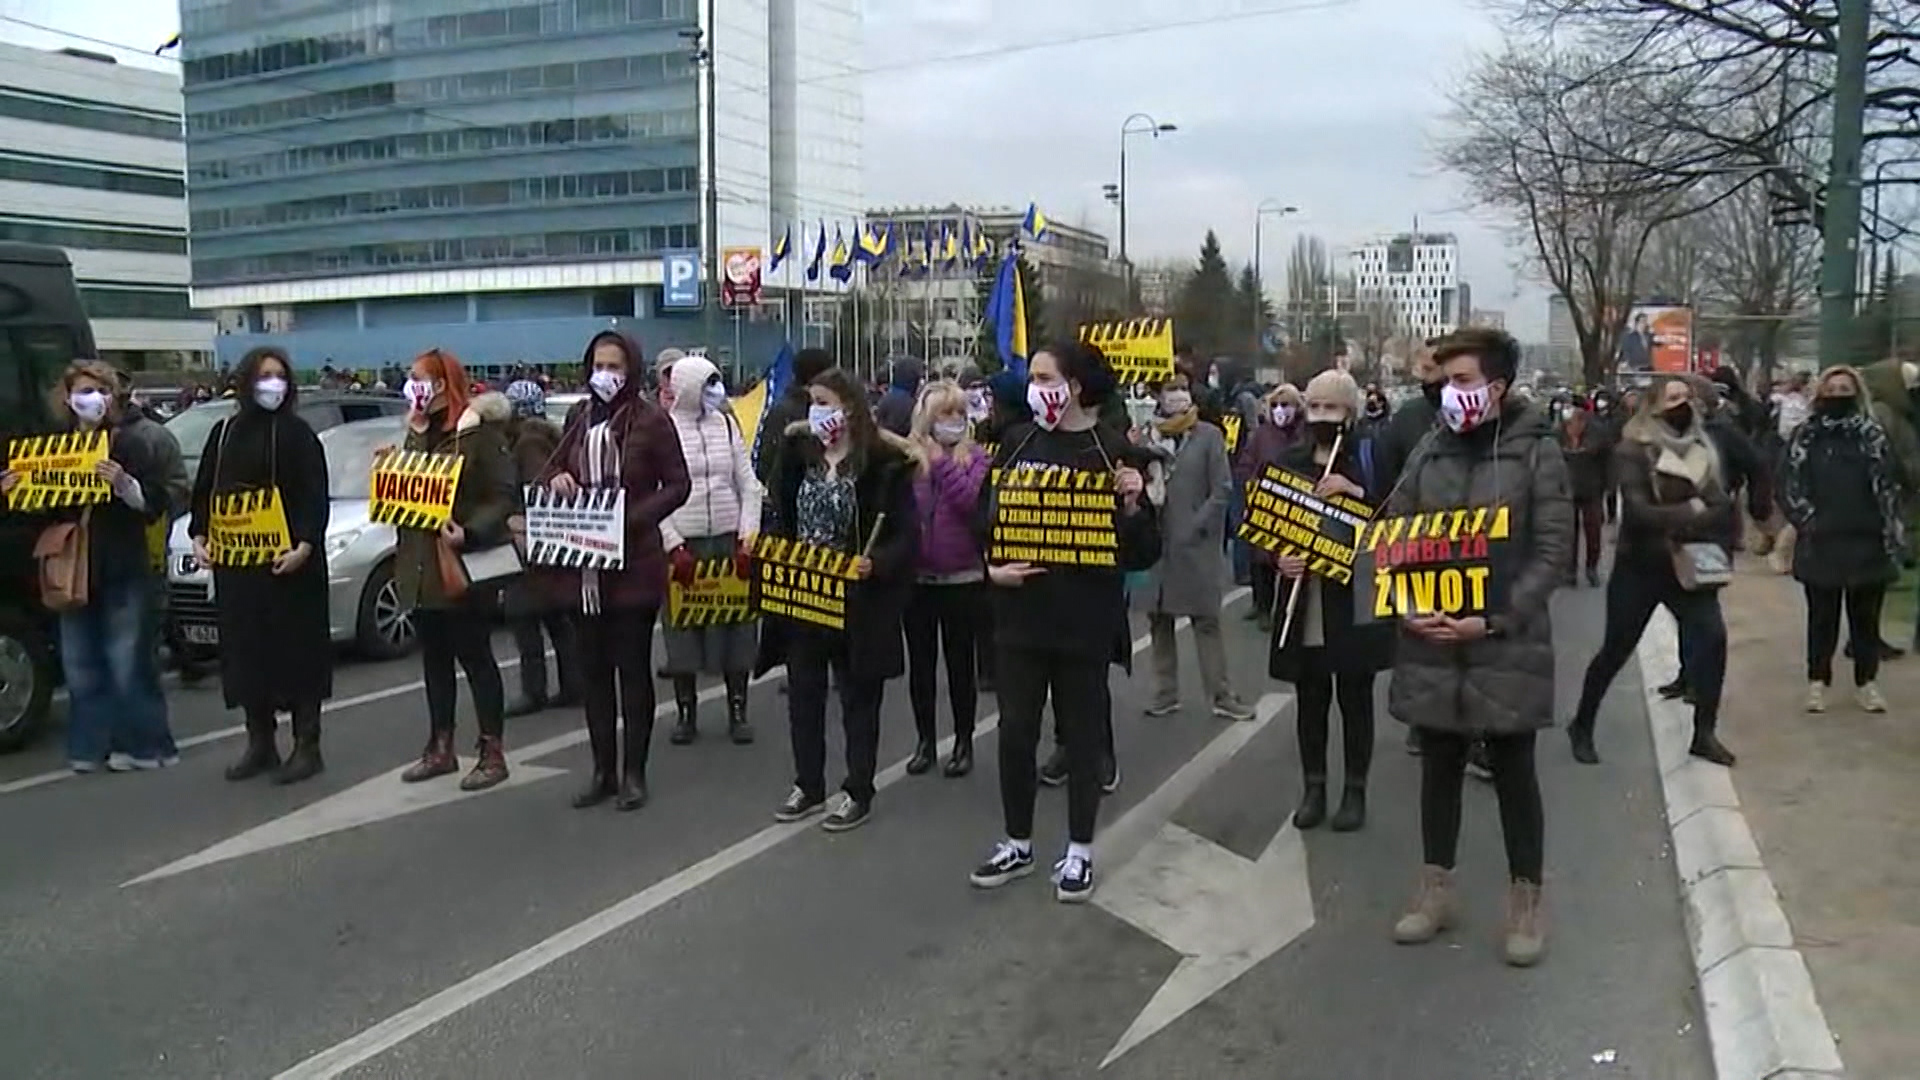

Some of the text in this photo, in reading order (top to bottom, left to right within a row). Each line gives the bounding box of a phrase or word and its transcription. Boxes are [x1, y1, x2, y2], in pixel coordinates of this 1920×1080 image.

[31, 470, 66, 486] GAME
[375, 473, 454, 506] VAKCINE
[1375, 533, 1488, 568] BORBA ZA
[762, 562, 845, 598] OSTAVKA
[1375, 567, 1489, 617] ŽIVOT
